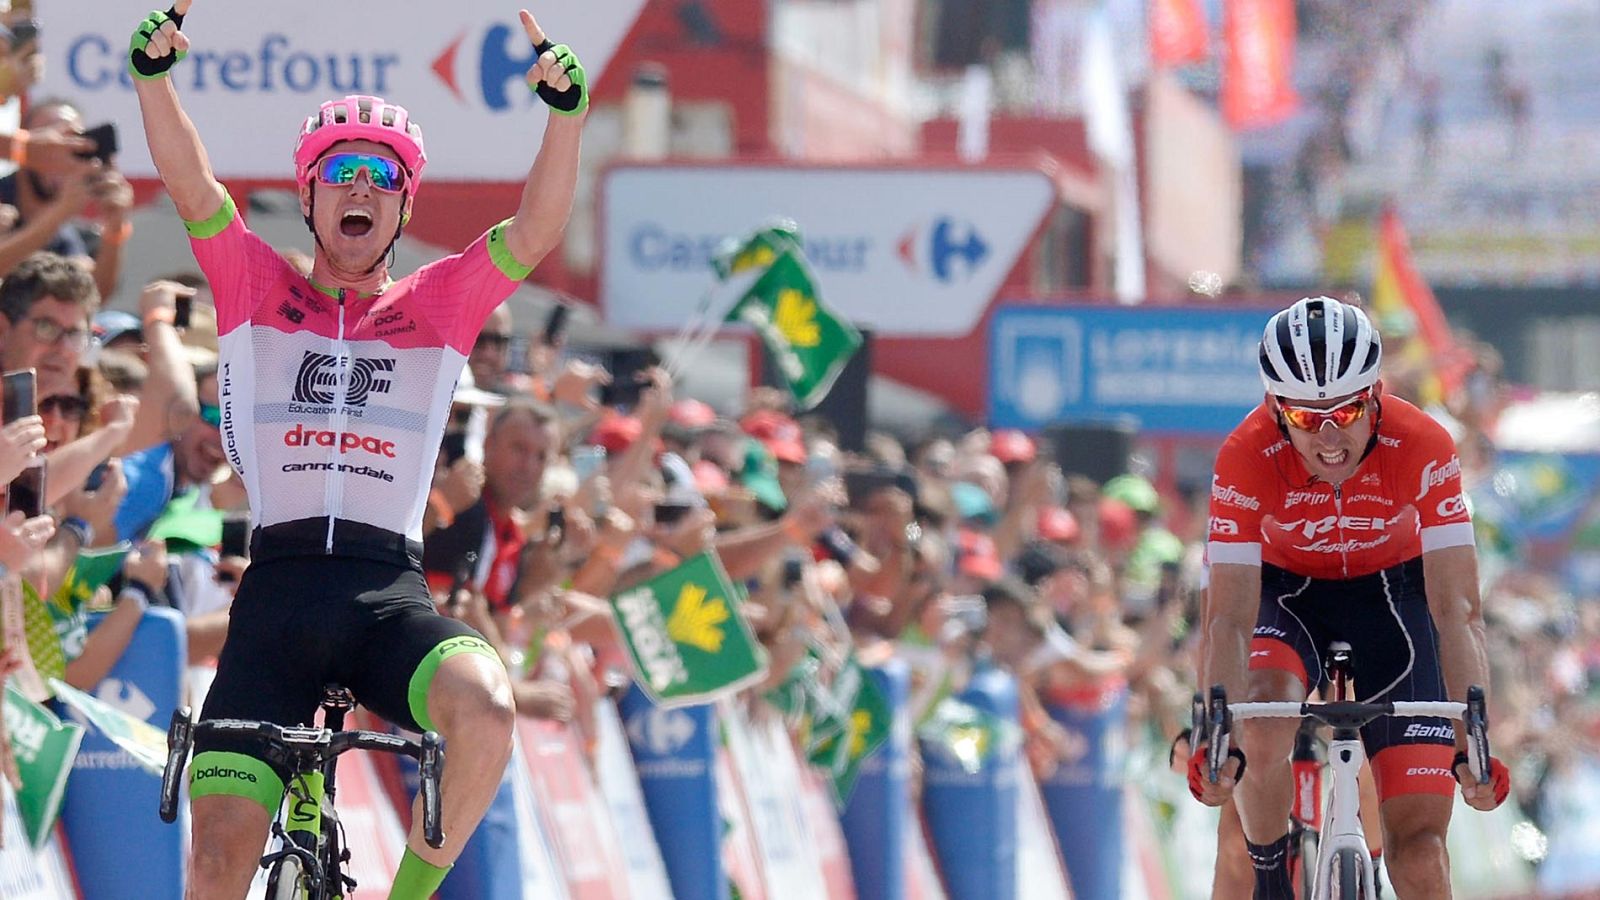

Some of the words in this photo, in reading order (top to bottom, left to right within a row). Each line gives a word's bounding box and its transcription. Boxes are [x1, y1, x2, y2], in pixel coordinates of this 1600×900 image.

[67, 32, 399, 93] Carefour
[288, 403, 337, 415] Education
[340, 407, 363, 418] First
[284, 423, 396, 459] drapac
[196, 766, 257, 783] balance
